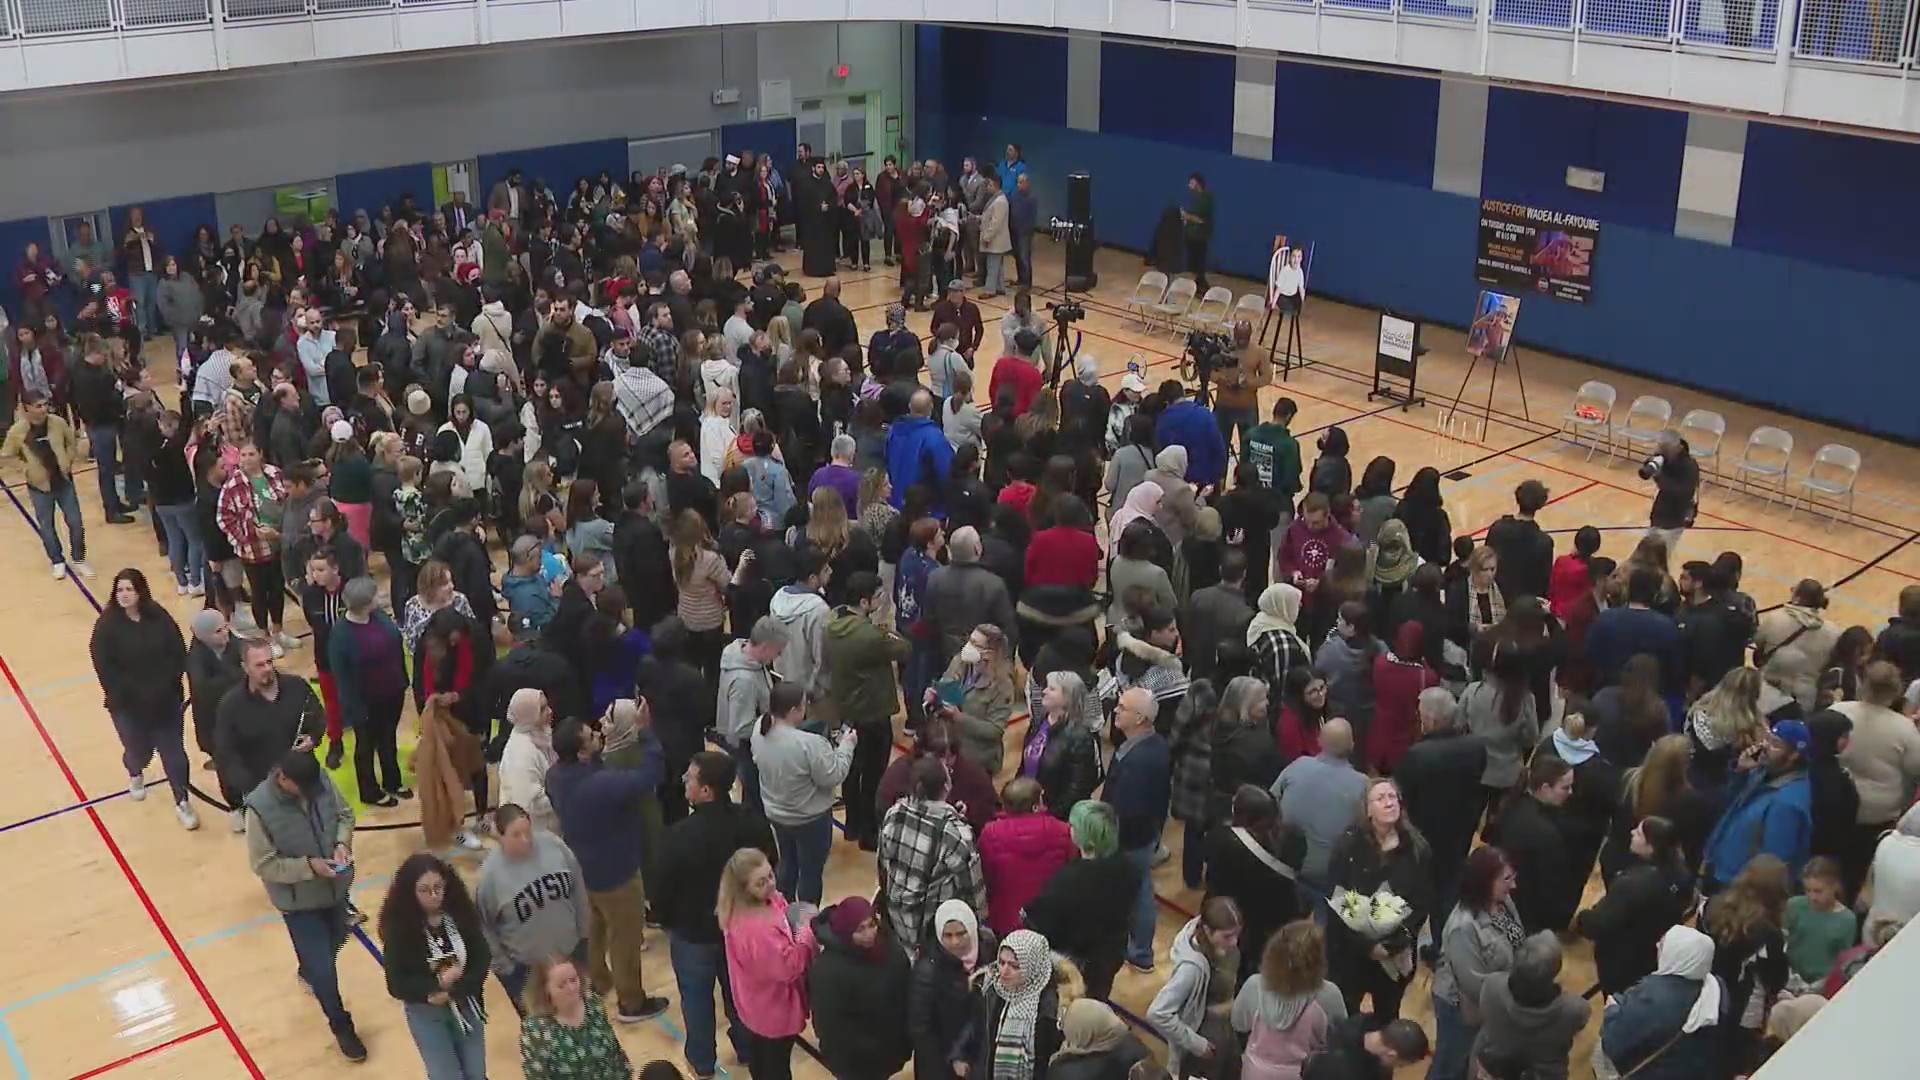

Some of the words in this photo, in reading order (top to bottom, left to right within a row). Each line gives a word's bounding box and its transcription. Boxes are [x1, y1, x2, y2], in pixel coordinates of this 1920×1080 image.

[1482, 200, 1511, 215] JUSTICE
[1512, 204, 1526, 217] FOR
[1527, 207, 1552, 222] WADEA
[1553, 212, 1599, 231] AL-FAYOUME
[512, 871, 570, 923] GVSU
